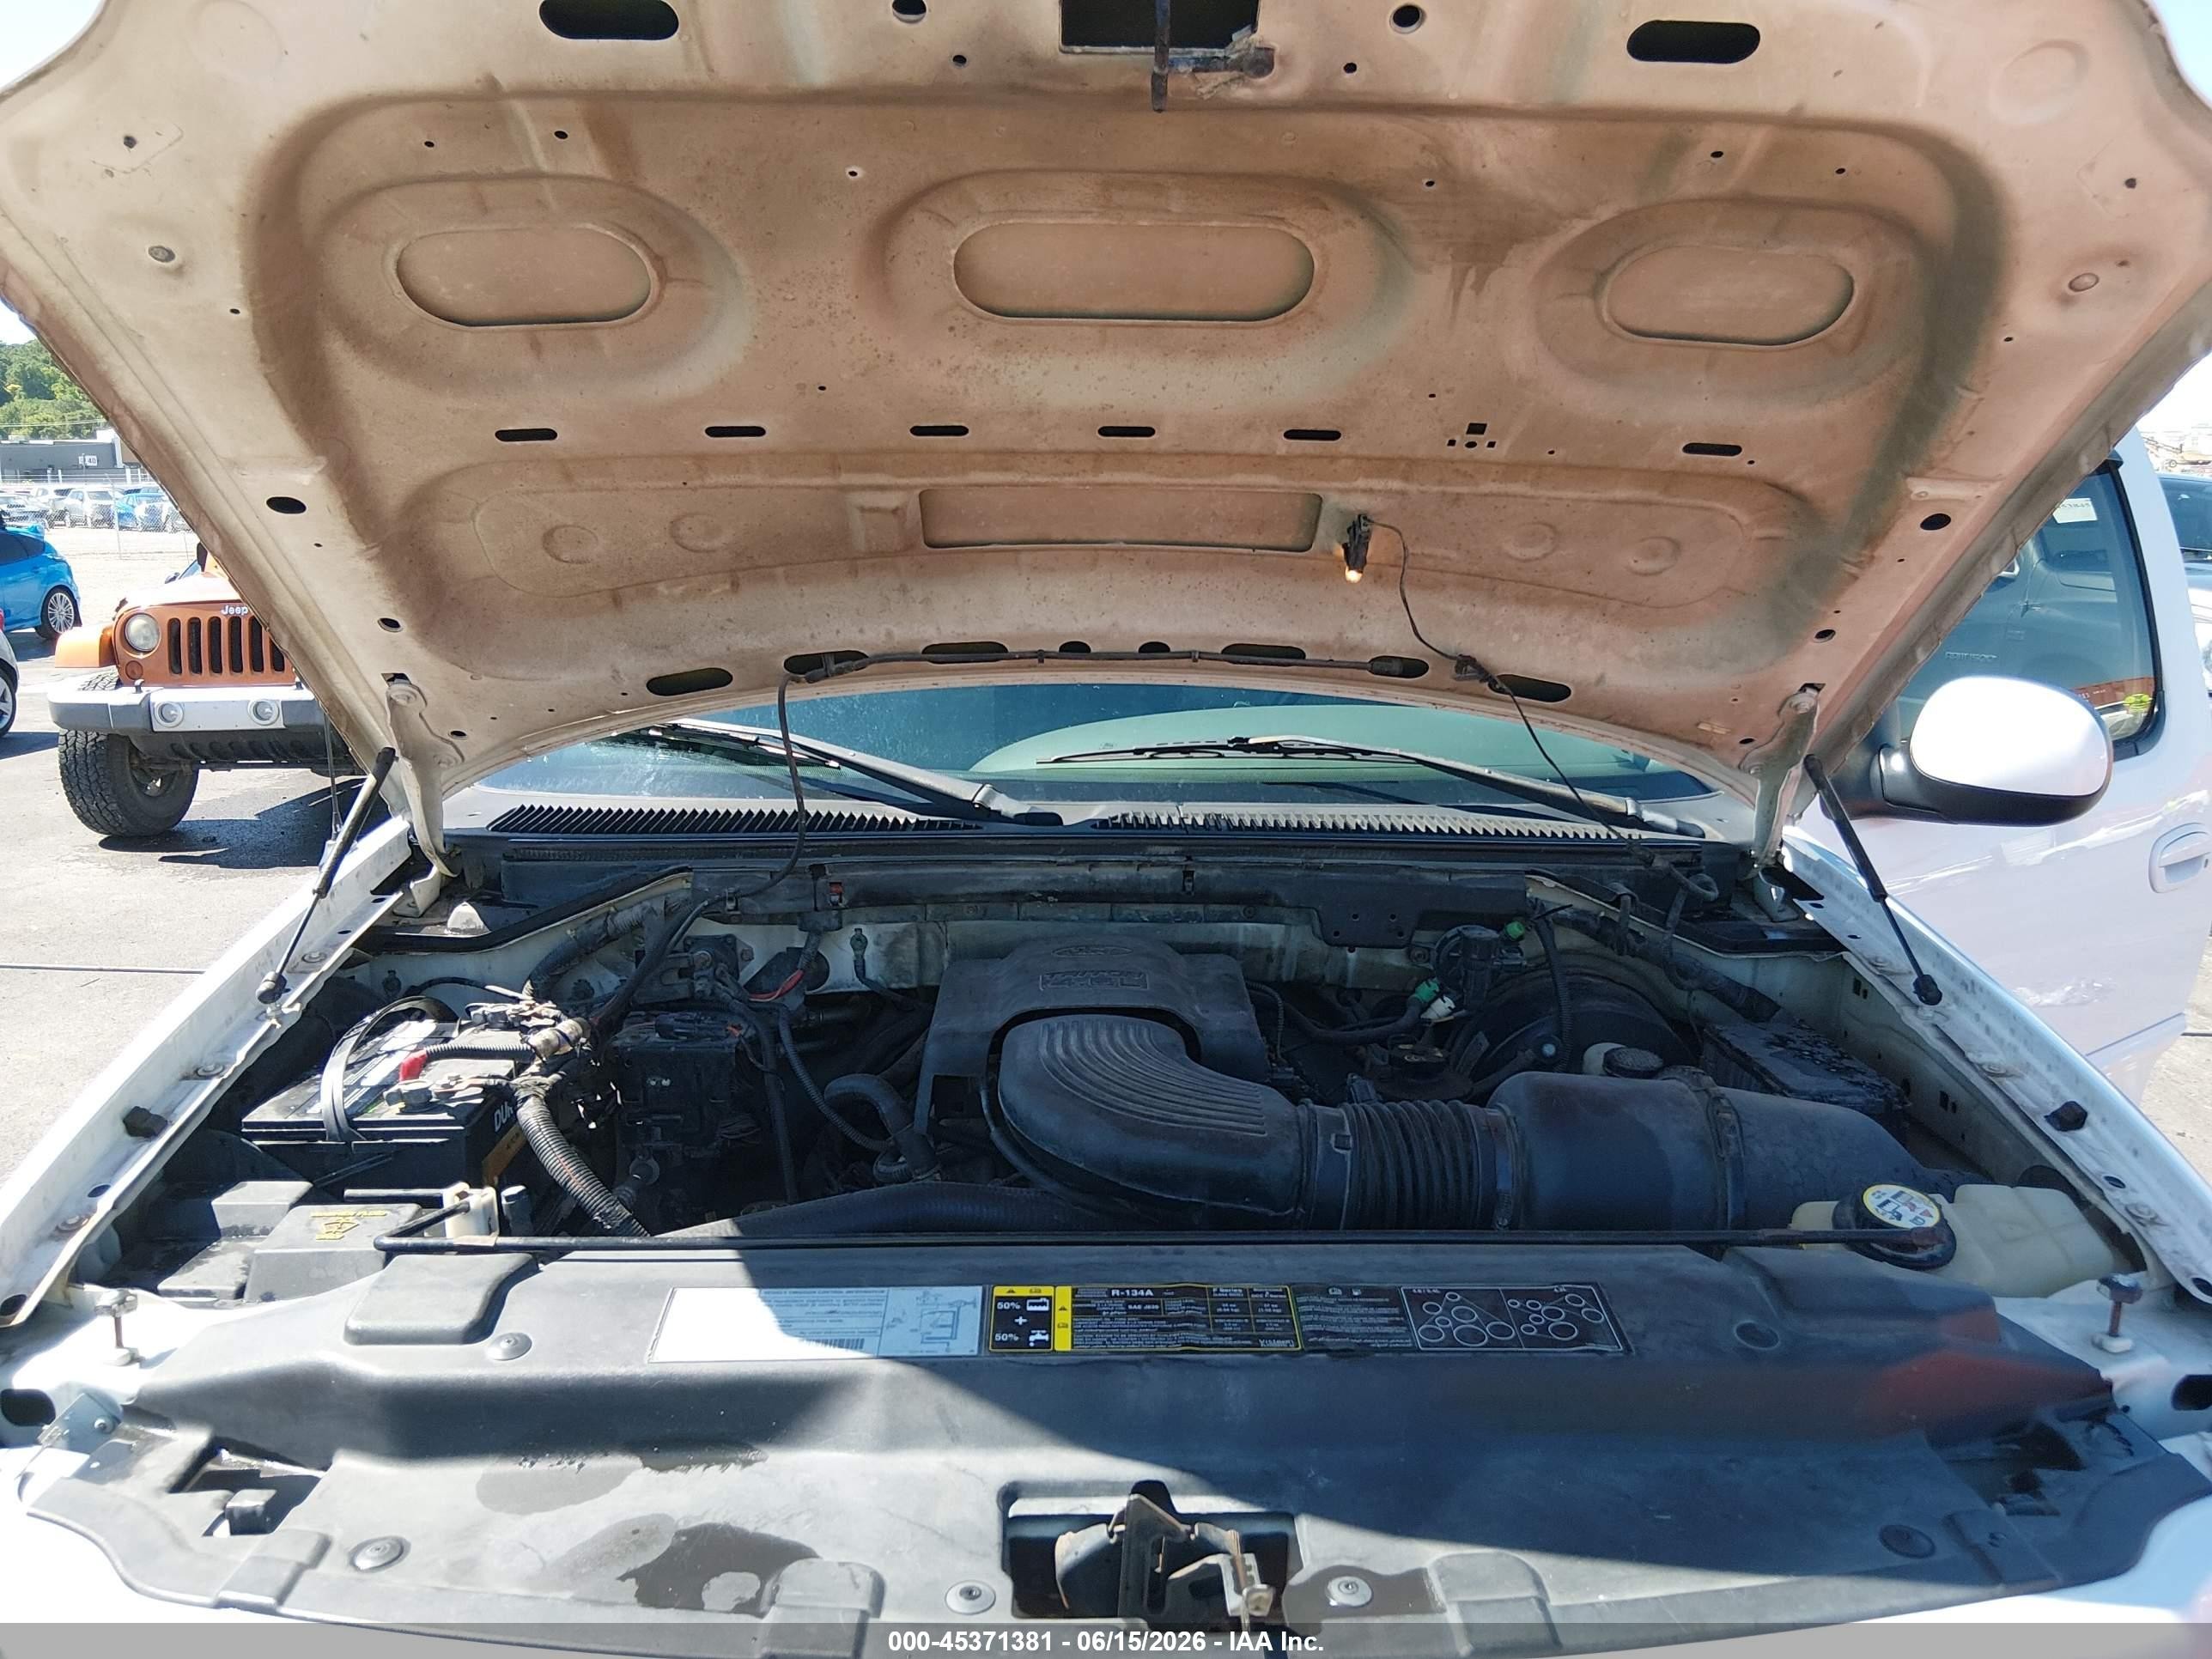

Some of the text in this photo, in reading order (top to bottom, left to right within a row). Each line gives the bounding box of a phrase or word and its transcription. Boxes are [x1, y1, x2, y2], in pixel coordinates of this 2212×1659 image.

[222, 605, 248, 616] Jeep
[1111, 1289, 1155, 1297] R-134A
[996, 1302, 1021, 1310] 50%
